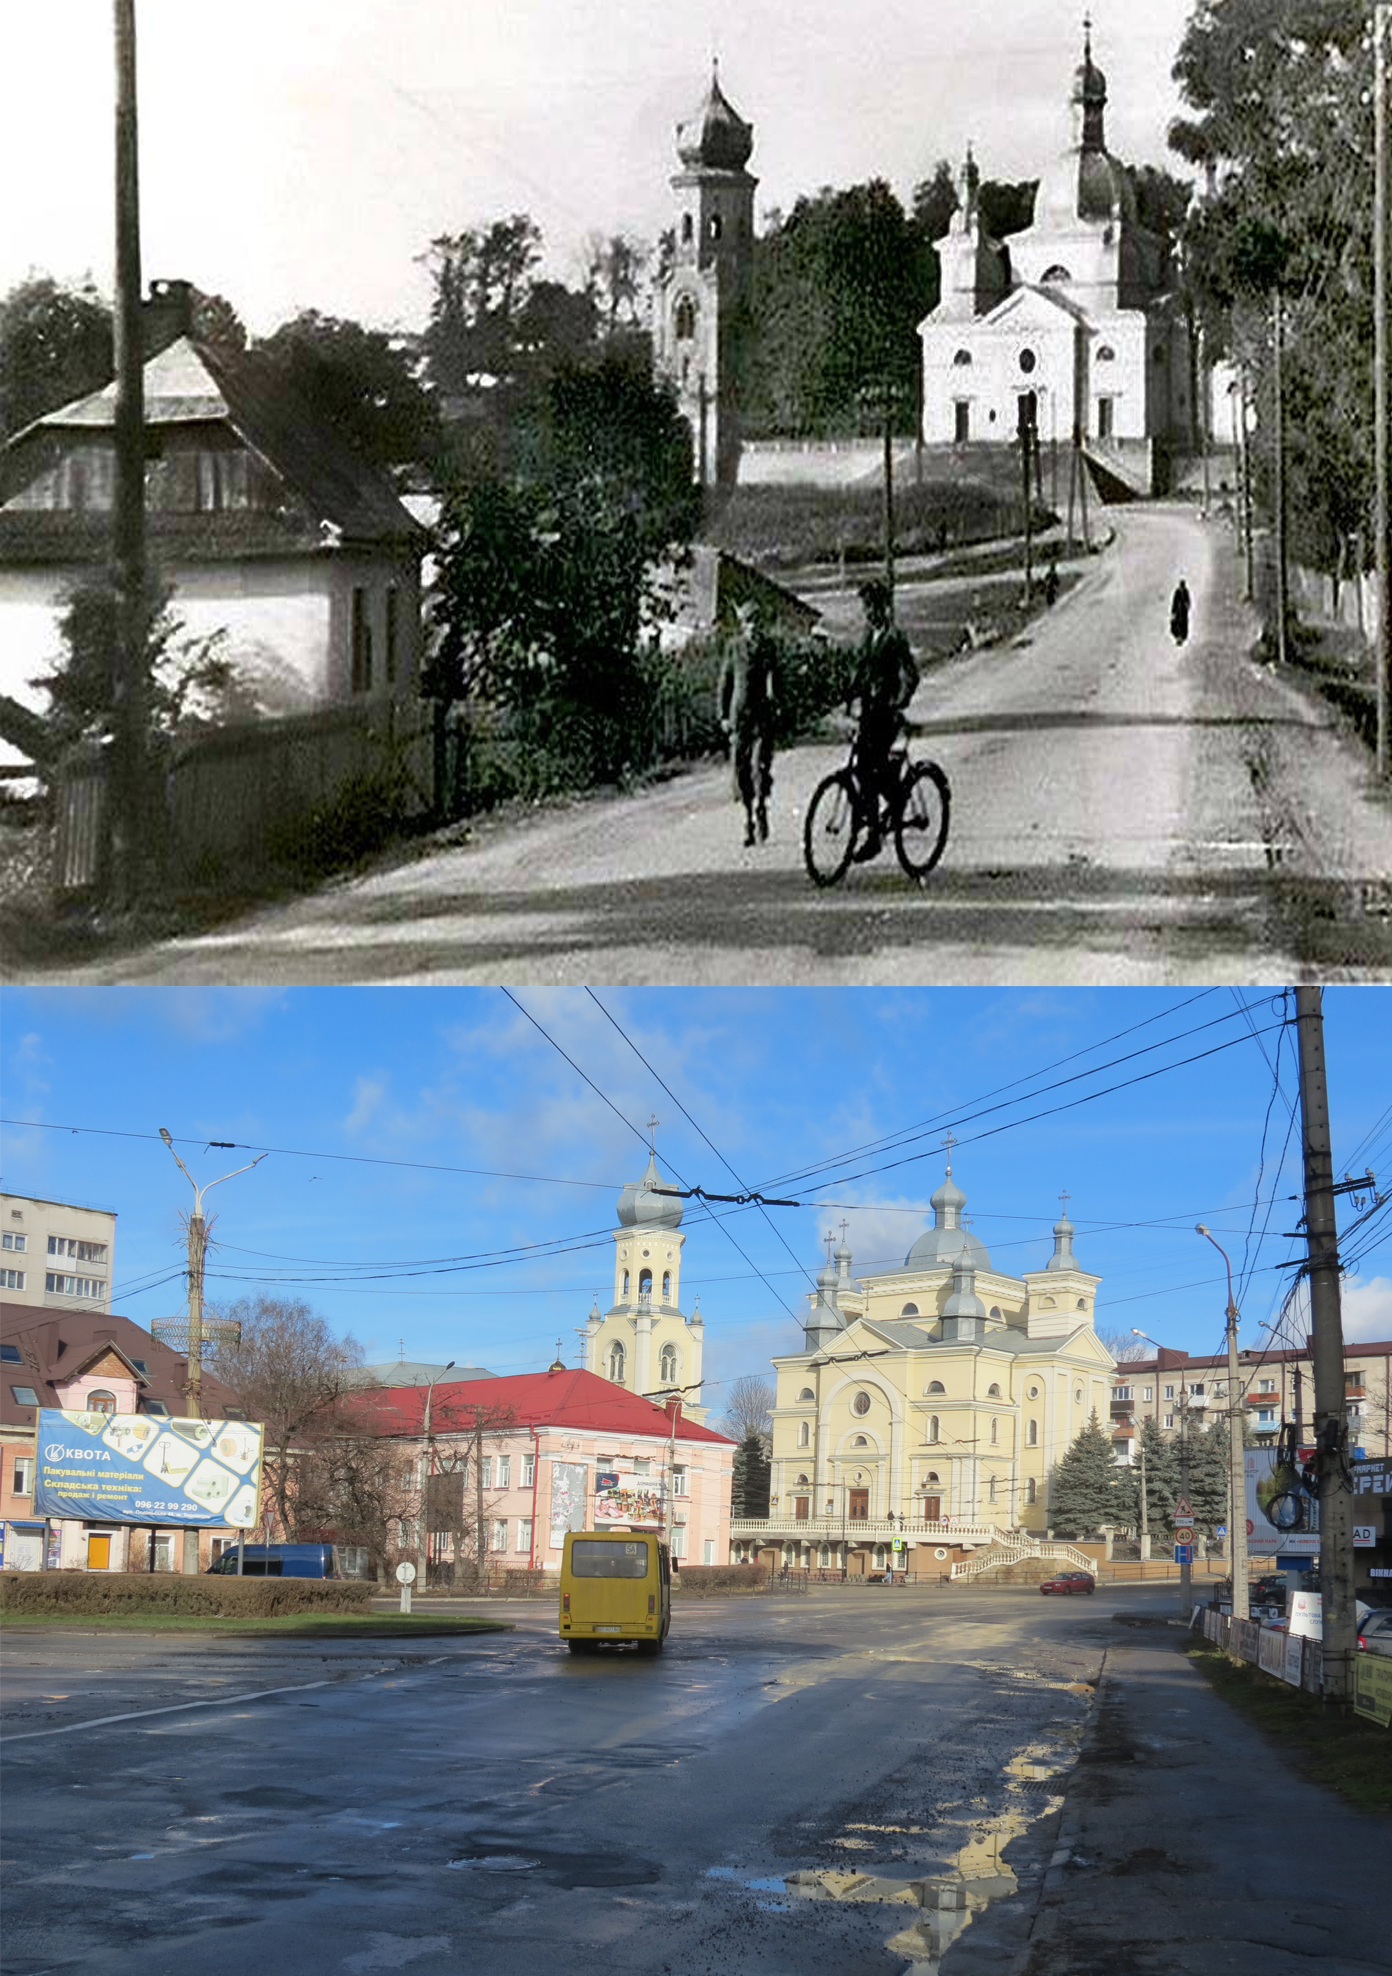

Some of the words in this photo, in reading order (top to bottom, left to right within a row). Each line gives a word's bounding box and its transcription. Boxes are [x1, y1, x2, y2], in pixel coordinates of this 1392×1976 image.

[66, 1449, 111, 1461] КВОТА
[43, 1466, 95, 1477] Пакувальні
[97, 1471, 144, 1480] матеріали
[44, 1479, 99, 1490] Складська
[101, 1484, 142, 1493] техніка:
[153, 1501, 165, 1509] 22
[167, 1502, 179, 1510] 99
[181, 1503, 198, 1511] 290
